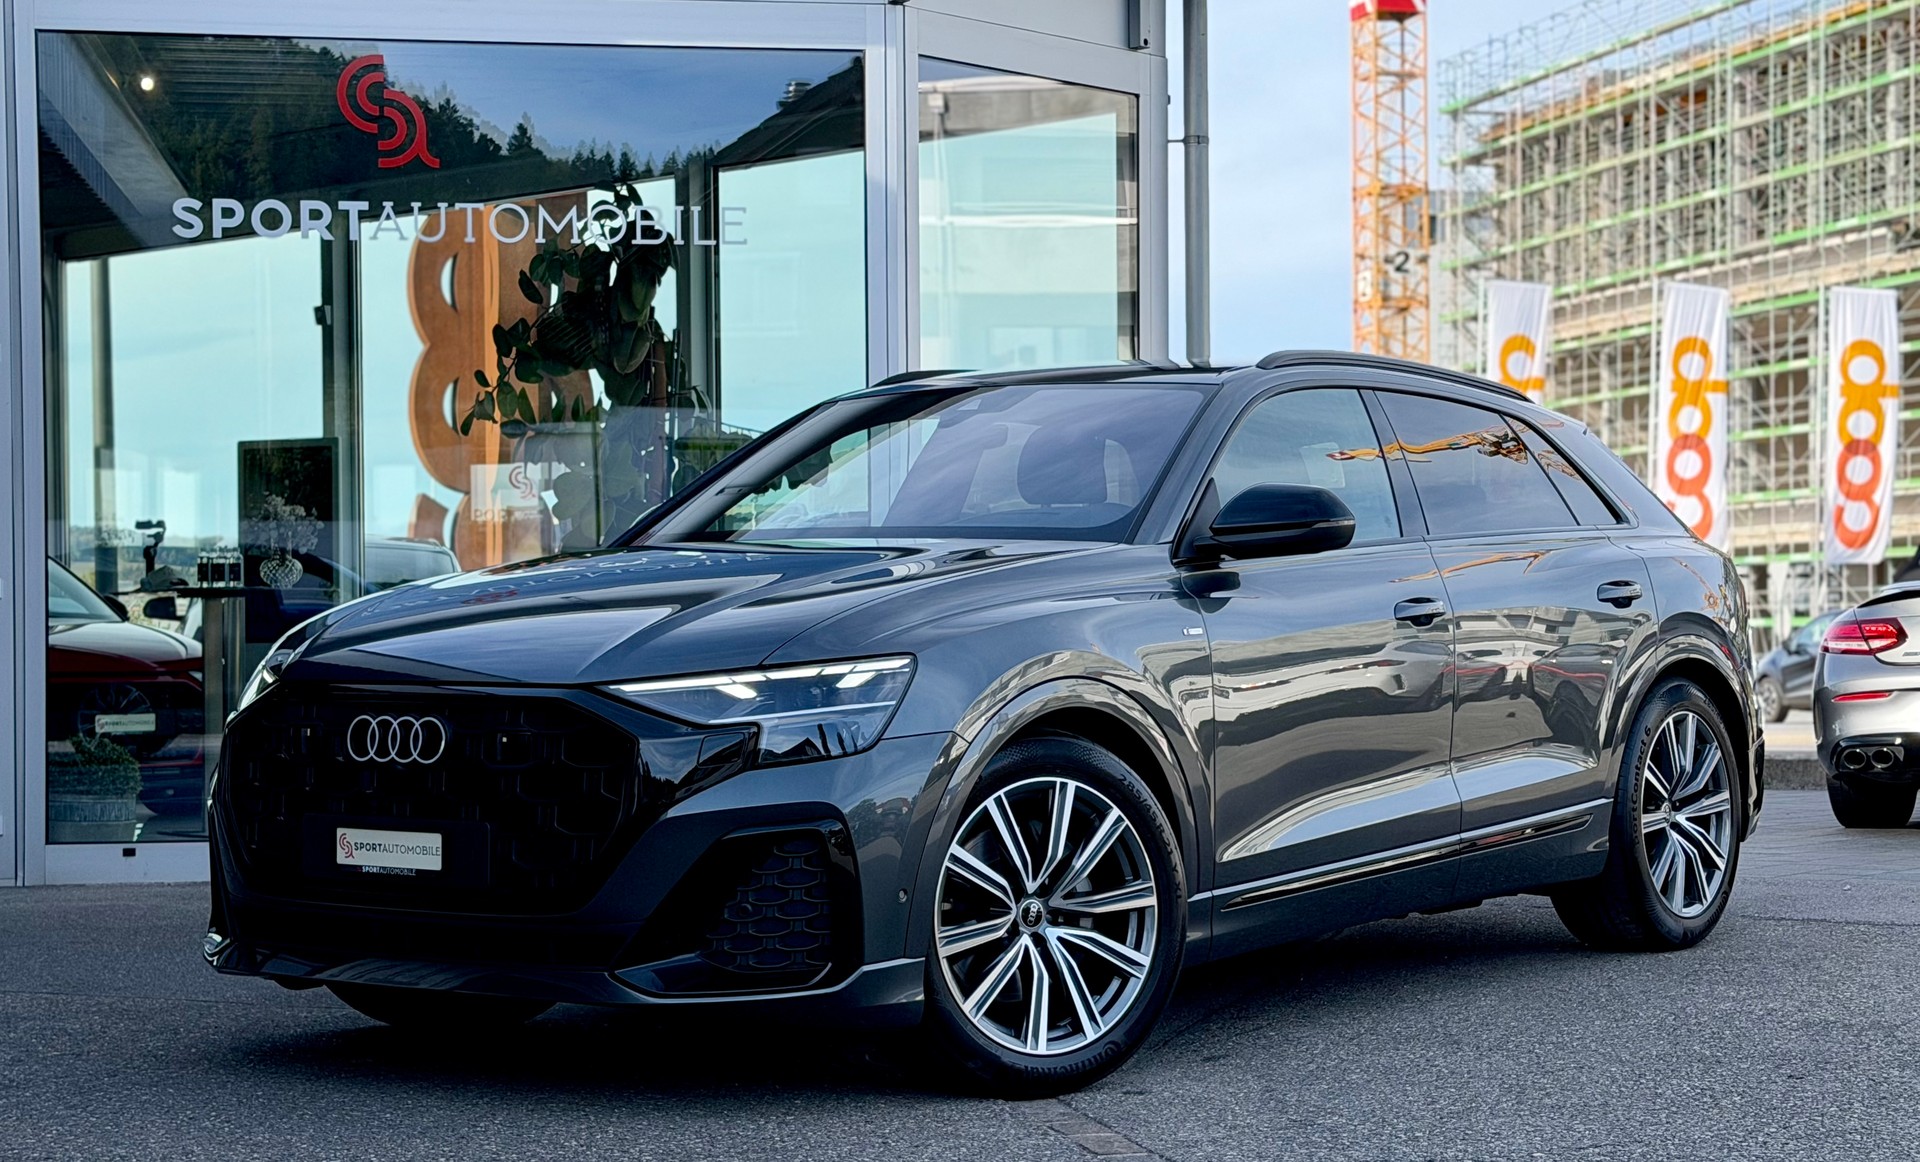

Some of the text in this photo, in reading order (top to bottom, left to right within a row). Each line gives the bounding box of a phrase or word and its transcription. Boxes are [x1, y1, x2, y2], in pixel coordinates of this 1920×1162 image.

[171, 197, 748, 246] SPORTAUTOMOBILE
[1394, 250, 1410, 274] 2
[1833, 339, 1899, 549] coop
[1644, 726, 1652, 738] 6
[1119, 773, 1159, 821] 285/45
[354, 842, 441, 856] SPORTAUTOMOBILE
[362, 866, 416, 876] SPORTAUTOMOBILE
